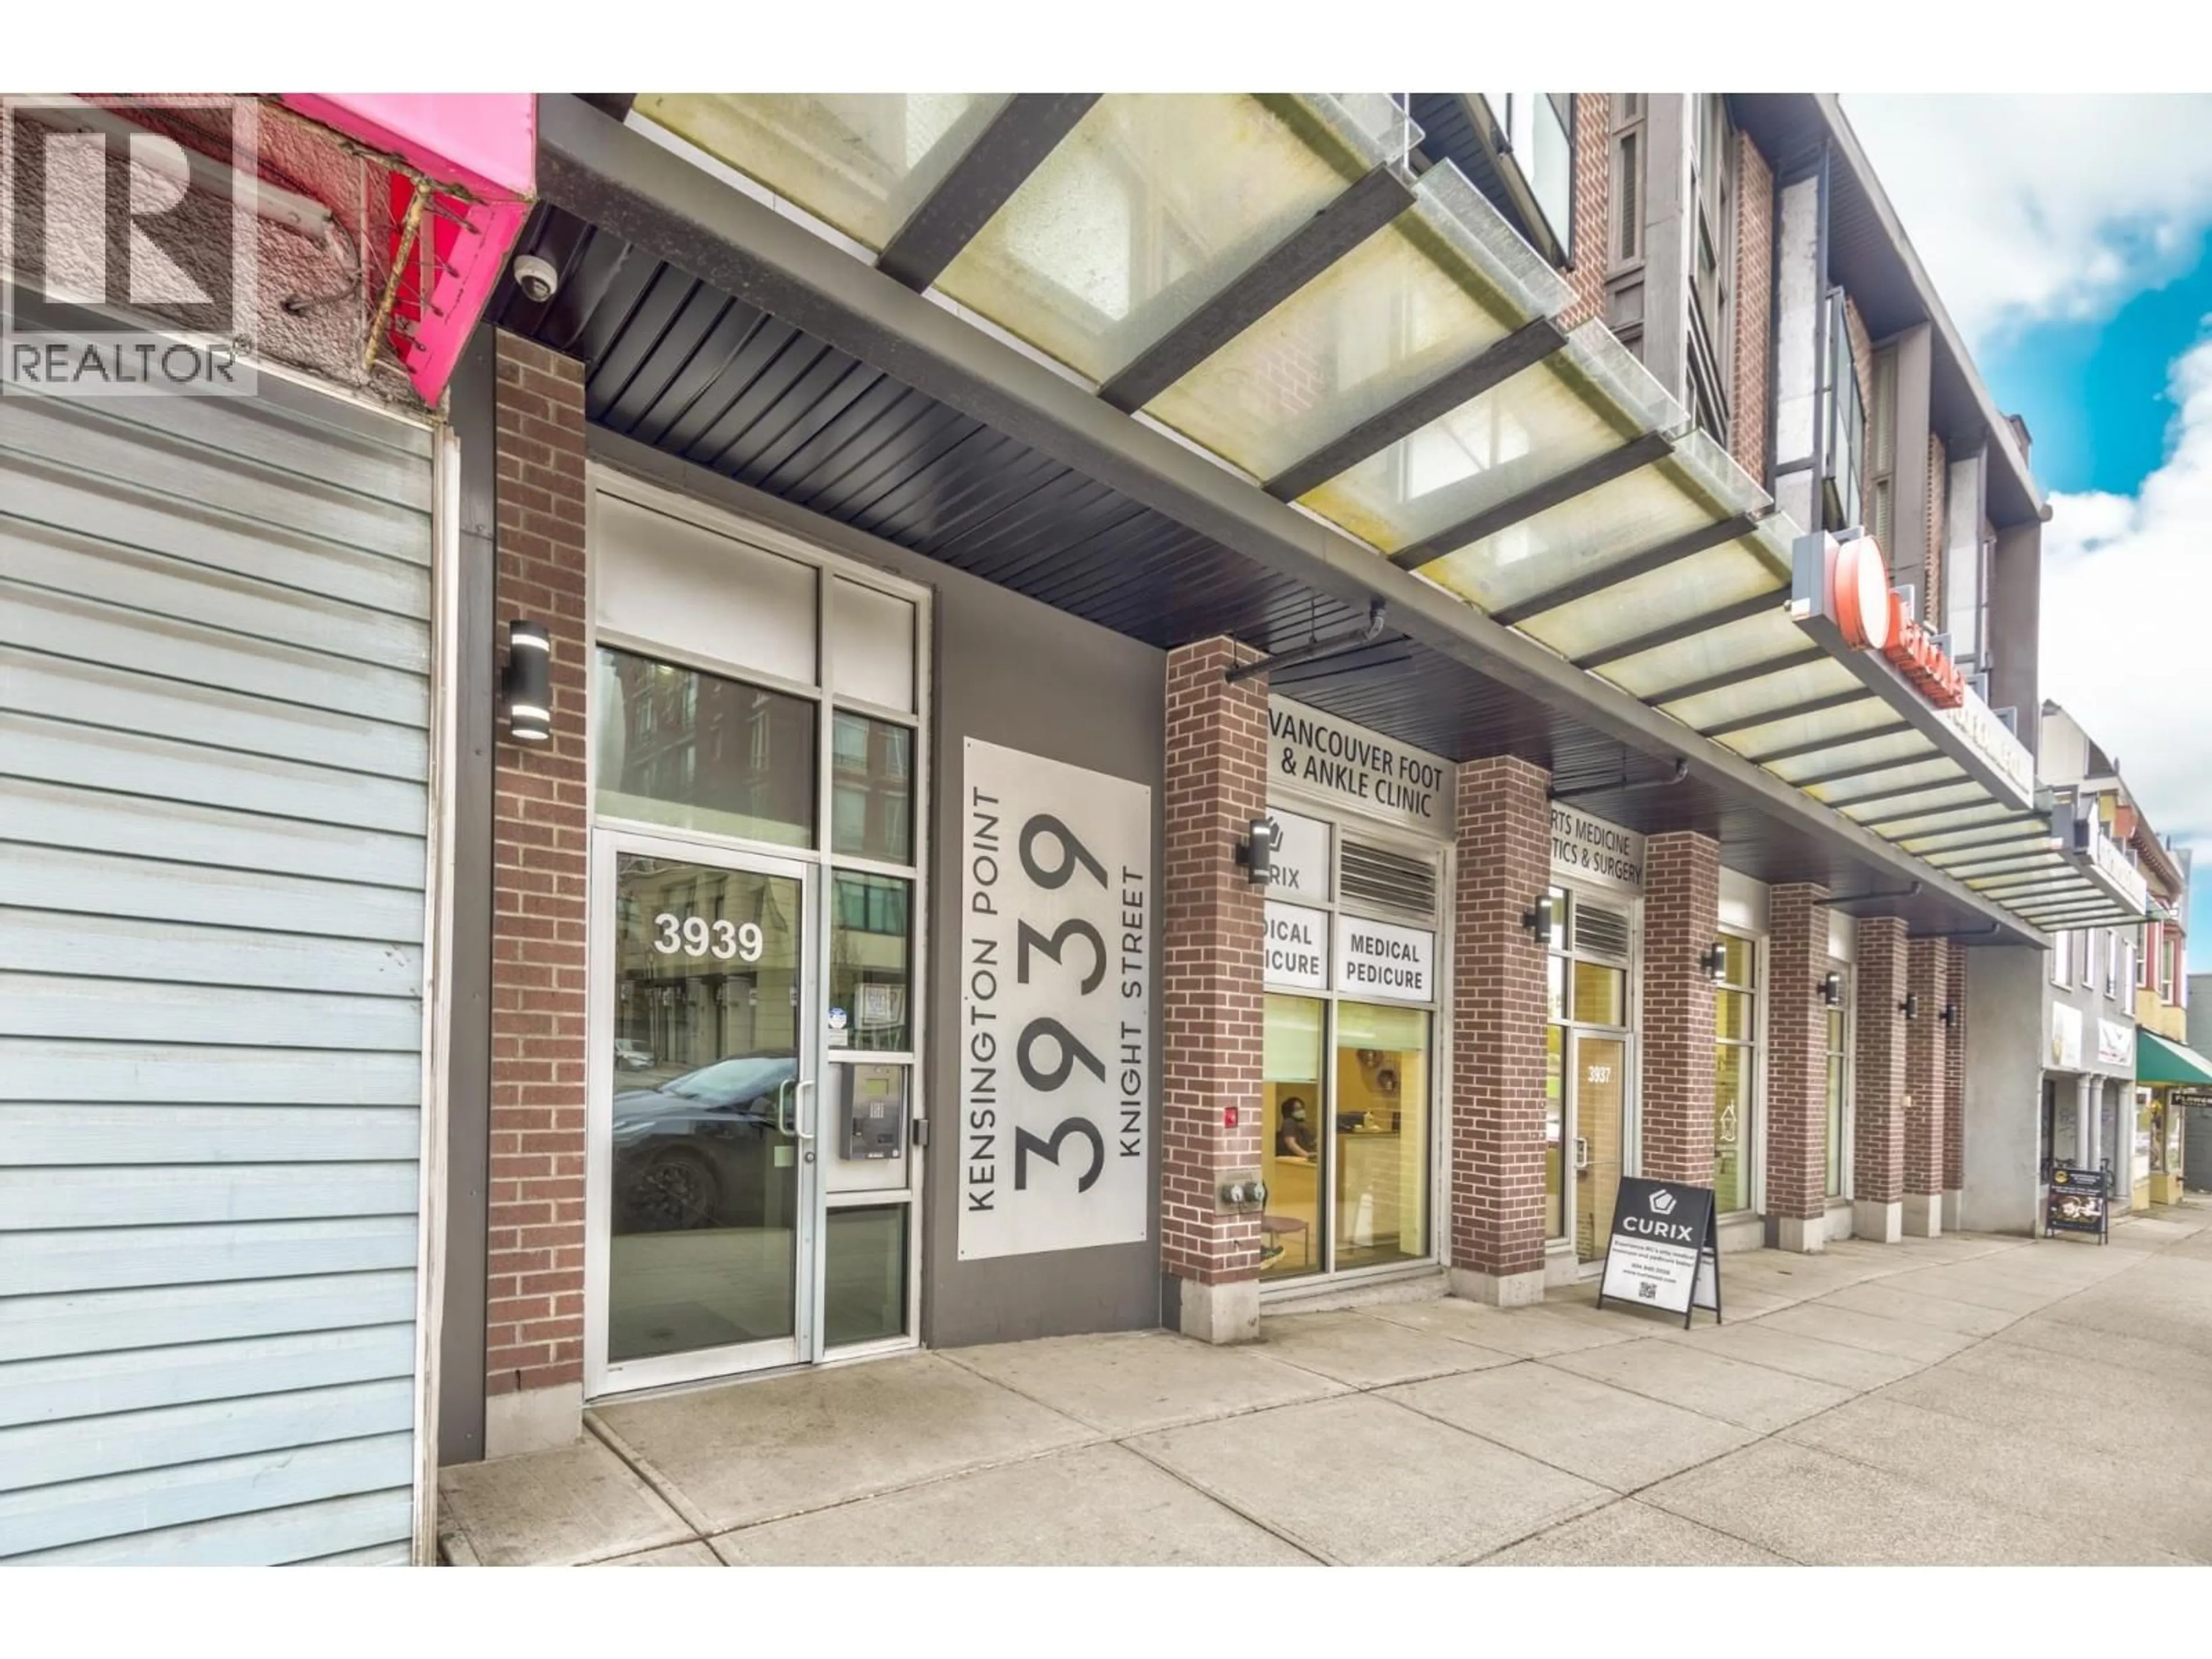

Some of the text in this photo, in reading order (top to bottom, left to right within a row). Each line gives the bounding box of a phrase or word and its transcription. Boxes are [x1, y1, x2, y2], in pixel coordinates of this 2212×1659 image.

[1268, 707, 1444, 792] VANCOUVER FOOT
[1281, 747, 1432, 817] & ANKLE CLINIC
[1575, 818, 1631, 856] MEDICINE
[1581, 848, 1590, 869] &
[1593, 851, 1642, 885] SURGERY
[654, 913, 764, 962] 3939
[1350, 933, 1420, 963] MEDICAL
[968, 786, 999, 1211] KENSINGTON POINT
[1347, 961, 1422, 990] PEDICURE
[1014, 813, 1108, 1194] 3939
[1120, 865, 1143, 1157] KNIGHT STREET
[1622, 1216, 1693, 1242] CURIX
